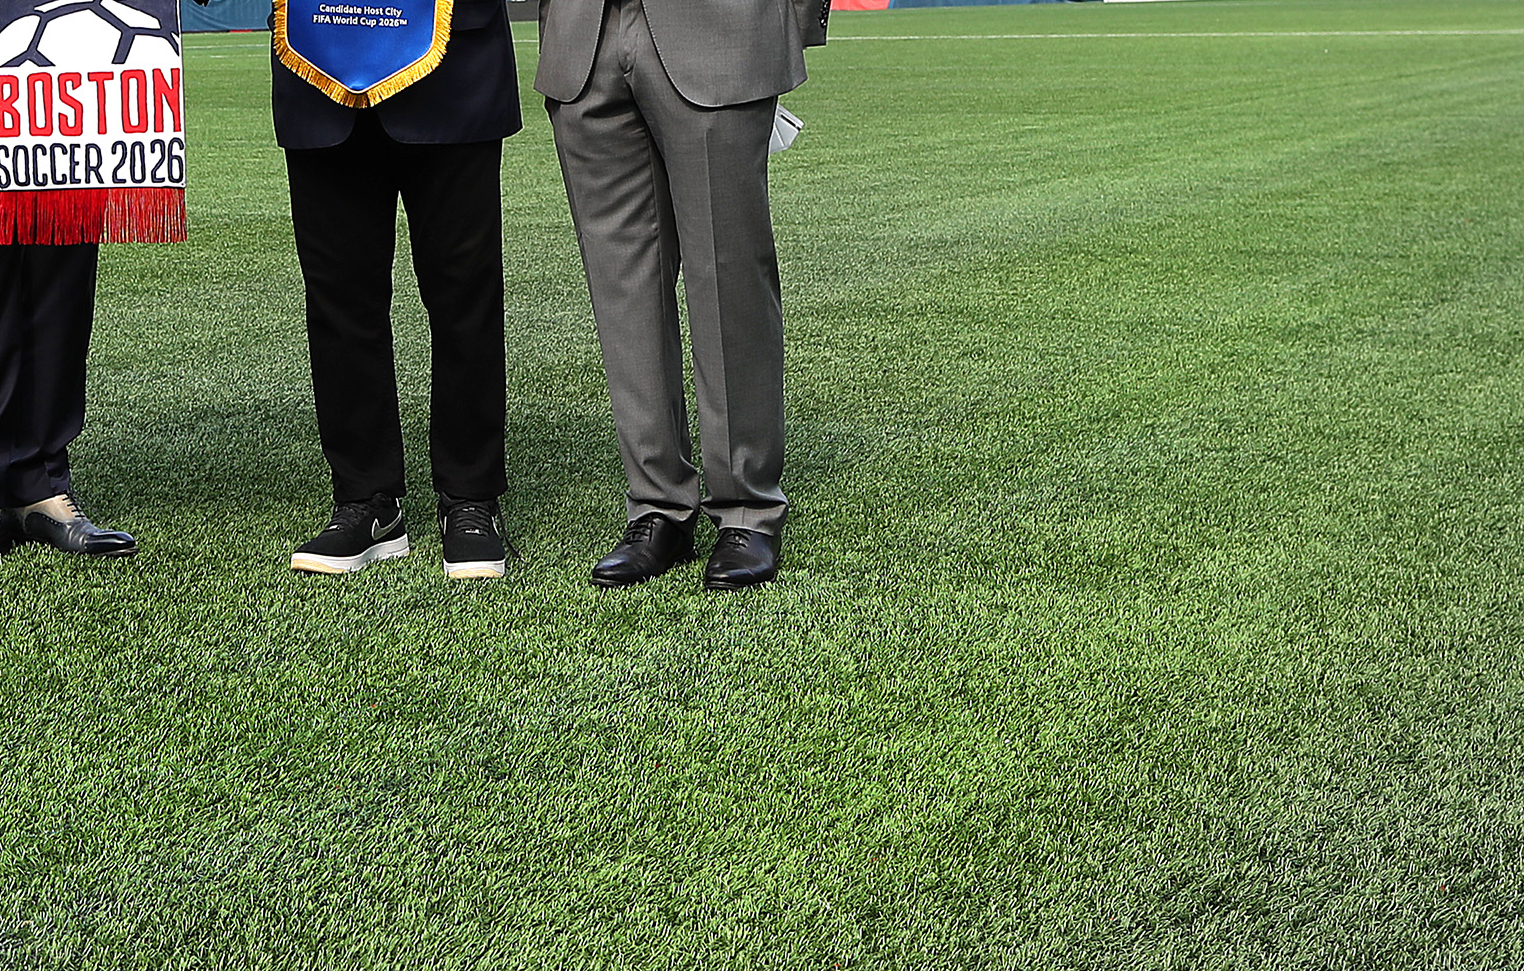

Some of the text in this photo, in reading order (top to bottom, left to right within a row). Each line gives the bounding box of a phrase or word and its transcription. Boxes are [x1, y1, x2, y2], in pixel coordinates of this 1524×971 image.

[319, 4, 403, 18] Candidate Host City
[313, 15, 331, 24] FIFA
[332, 16, 358, 26] World
[360, 17, 377, 28] Cup
[111, 137, 185, 184] 2026
